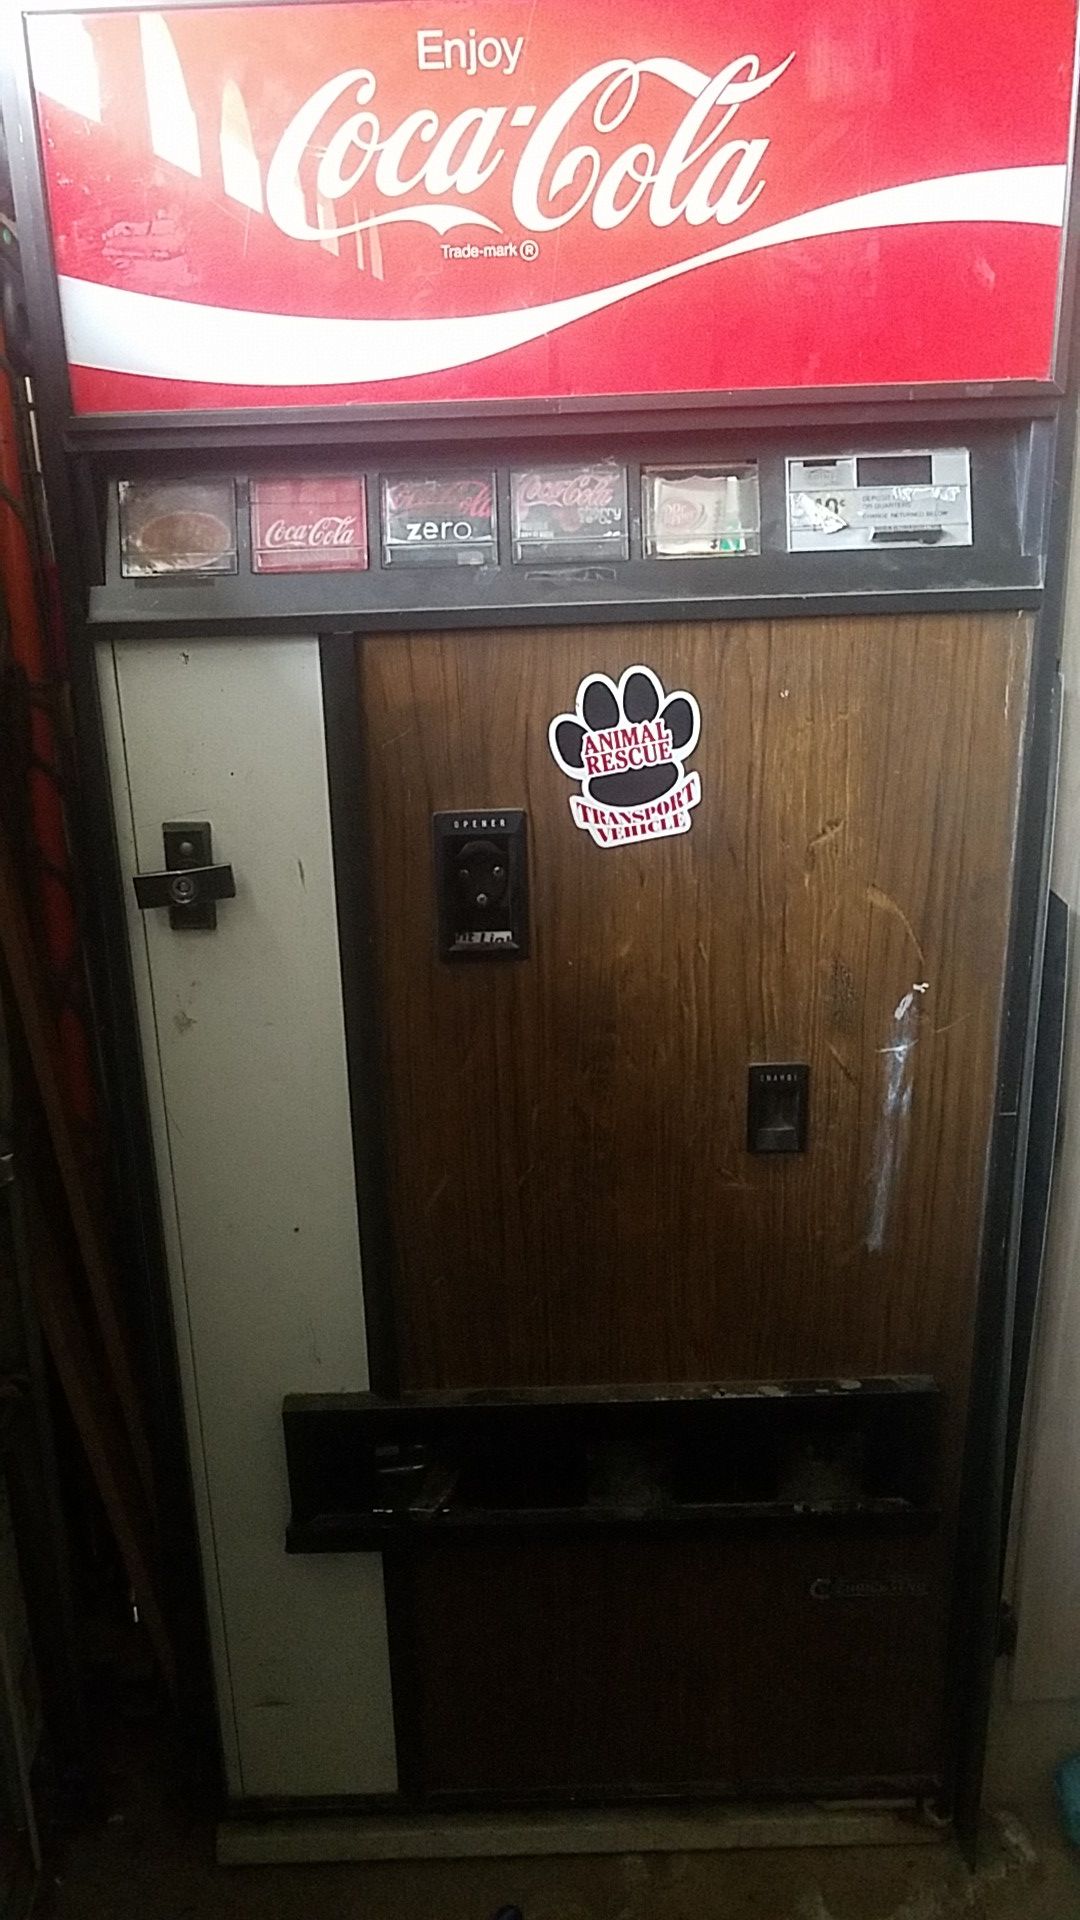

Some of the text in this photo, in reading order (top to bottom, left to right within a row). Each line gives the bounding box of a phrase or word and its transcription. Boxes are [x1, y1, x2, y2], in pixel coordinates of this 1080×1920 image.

[417, 28, 524, 75] Enjoy
[266, 50, 797, 241] Coca-Cola
[441, 242, 518, 259] Trade-mark
[264, 516, 357, 548] Coca-Cola
[406, 521, 472, 541] zero
[584, 721, 670, 756] ANIMAL
[585, 741, 673, 776] RESCUE
[575, 778, 696, 826] TRANSPORT
[453, 818, 506, 829] OPENER
[597, 811, 687, 843] VEHICLE
